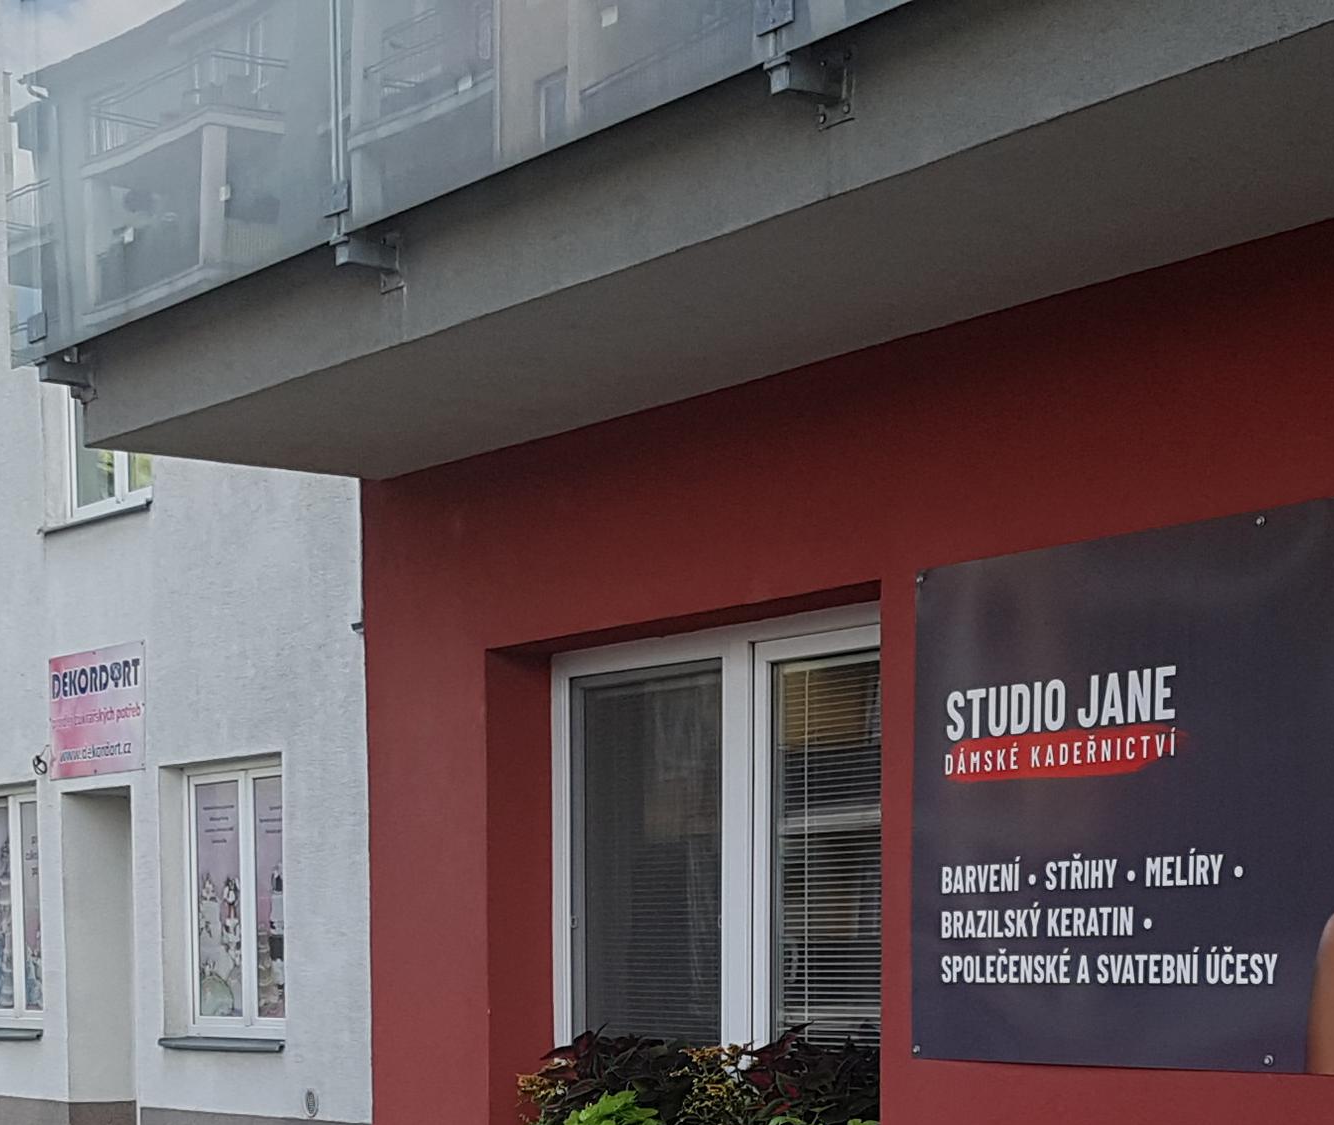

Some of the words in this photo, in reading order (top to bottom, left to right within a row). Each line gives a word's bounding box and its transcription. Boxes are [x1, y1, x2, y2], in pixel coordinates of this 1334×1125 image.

[946, 678, 1067, 741] STUDIO
[1077, 665, 1177, 728] JANE
[944, 742, 1019, 776] DÁMSKÉ
[1030, 727, 1177, 768] KADEŘNICTVÍ
[941, 856, 1021, 894] BARVENÍ
[1045, 853, 1118, 891] STŘIHY
[1145, 848, 1224, 887] MELÍRY
[941, 901, 1042, 939] BRAZILSKÝ
[1047, 906, 1134, 938] KERATIN
[941, 948, 1071, 984] SPOLEČENSKÉ
[1076, 955, 1091, 984] A
[1097, 947, 1200, 985] SVATEBNÍ
[1205, 946, 1278, 985] ÚČESY
